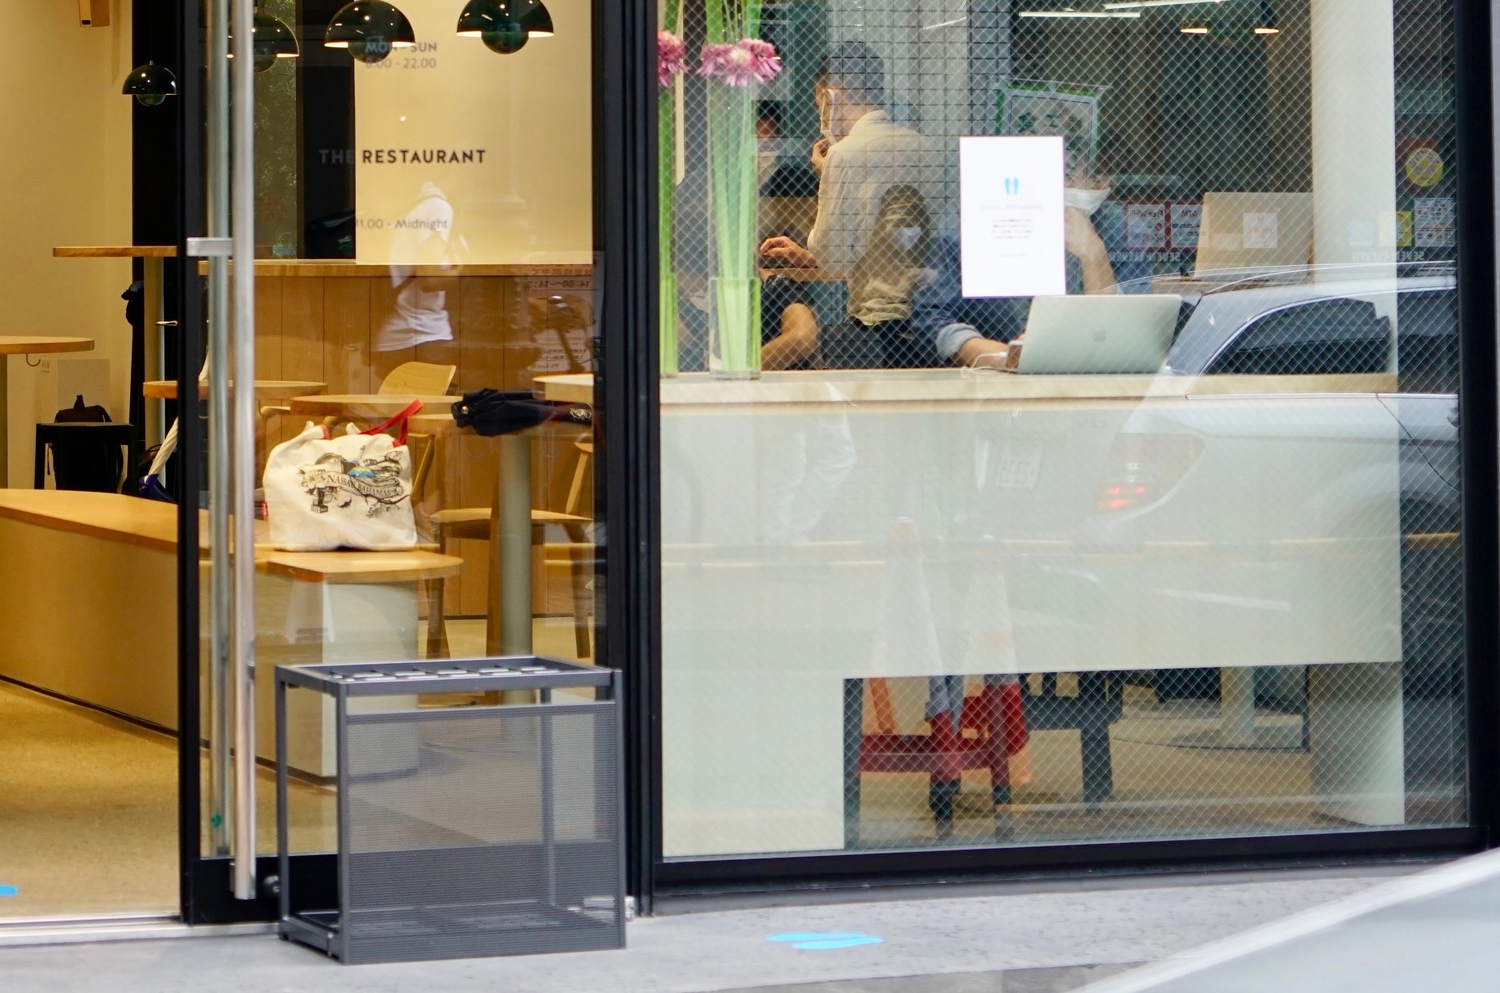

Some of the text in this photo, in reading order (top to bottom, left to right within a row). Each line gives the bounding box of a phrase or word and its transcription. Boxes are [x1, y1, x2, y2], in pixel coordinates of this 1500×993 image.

[410, 42, 437, 53] SUN
[403, 58, 437, 69] 22.00
[319, 149, 487, 164] THE RESTAURANT
[395, 218, 448, 232] Midnight
[358, 482, 391, 496] BAHAMAS
